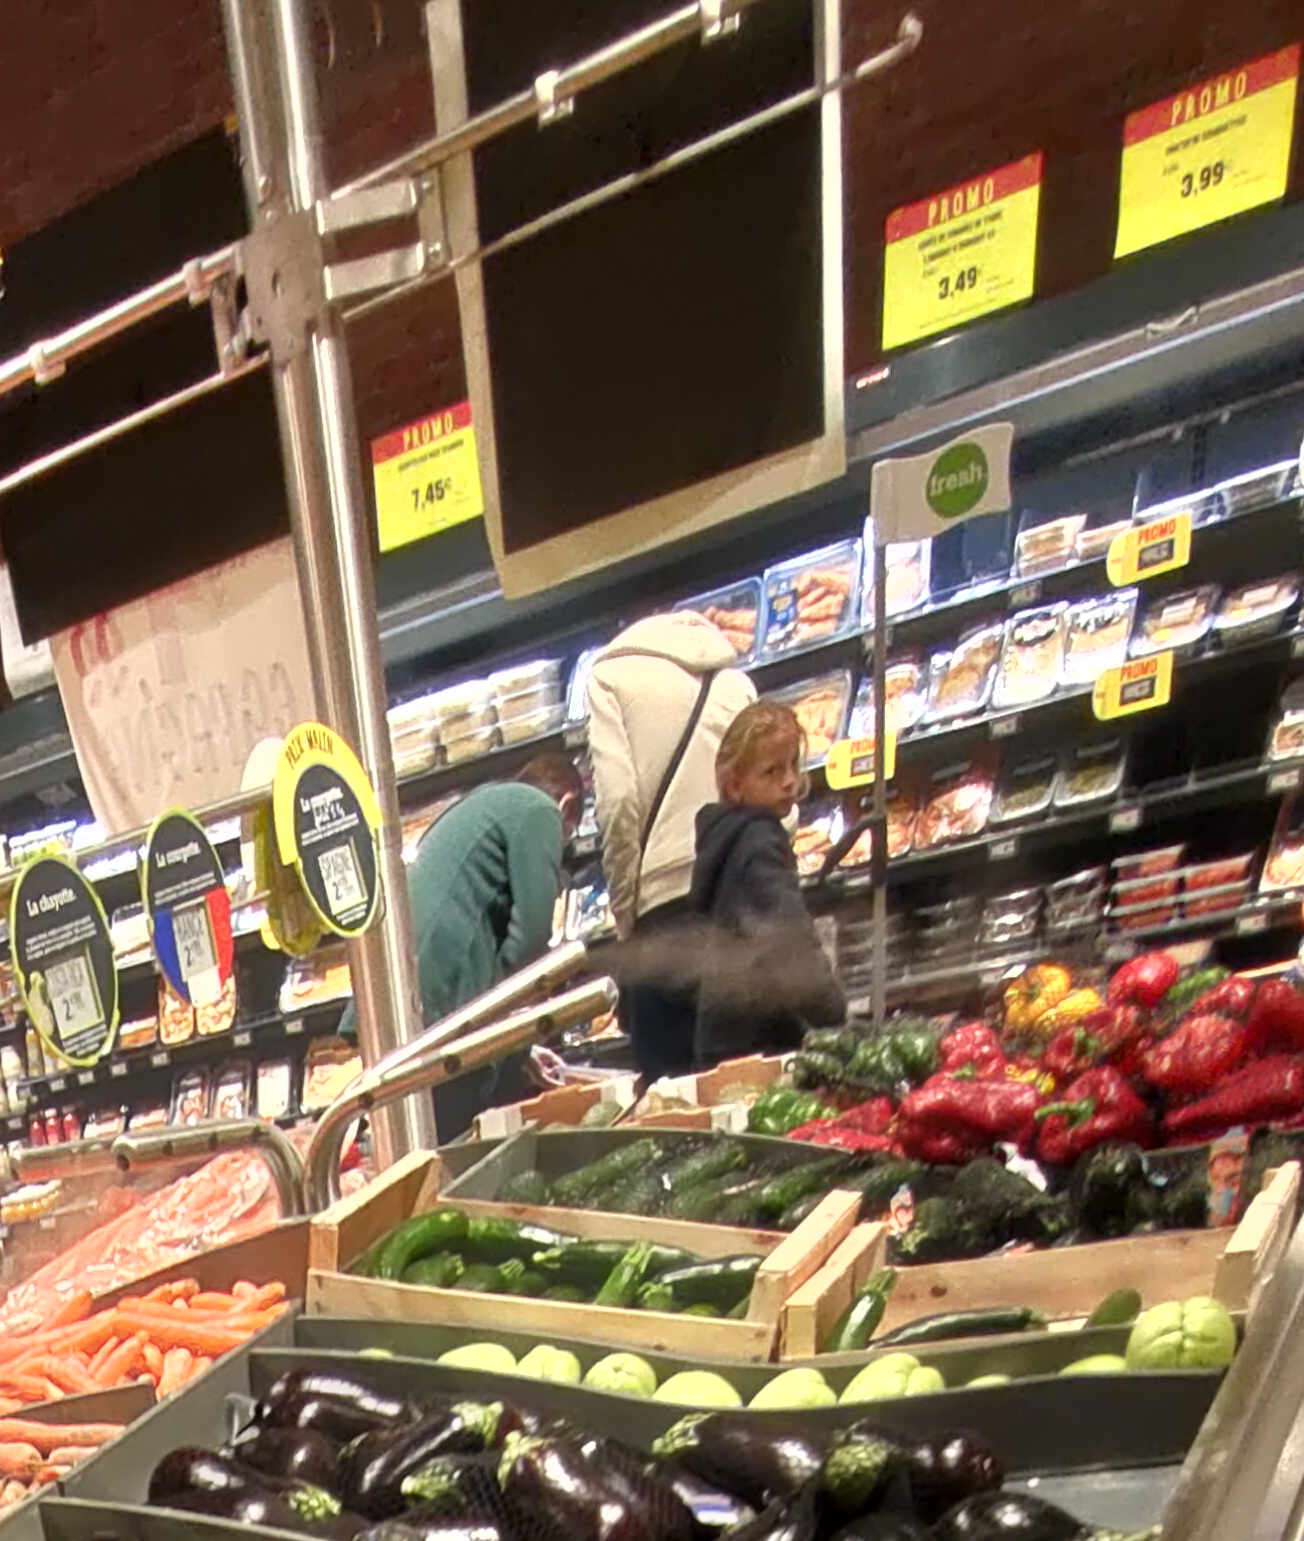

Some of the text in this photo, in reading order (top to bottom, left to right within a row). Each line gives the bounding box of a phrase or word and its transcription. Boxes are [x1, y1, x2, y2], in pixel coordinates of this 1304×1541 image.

[1171, 71, 1247, 126] PROMO
[928, 177, 994, 227] PROMO
[403, 412, 453, 450] PROMO
[1137, 518, 1176, 545] PROMO
[1120, 658, 1158, 682] PROMO
[285, 729, 333, 771] PRIX MALIN
[850, 739, 876, 755] PROM
[26, 899, 39, 917] La
